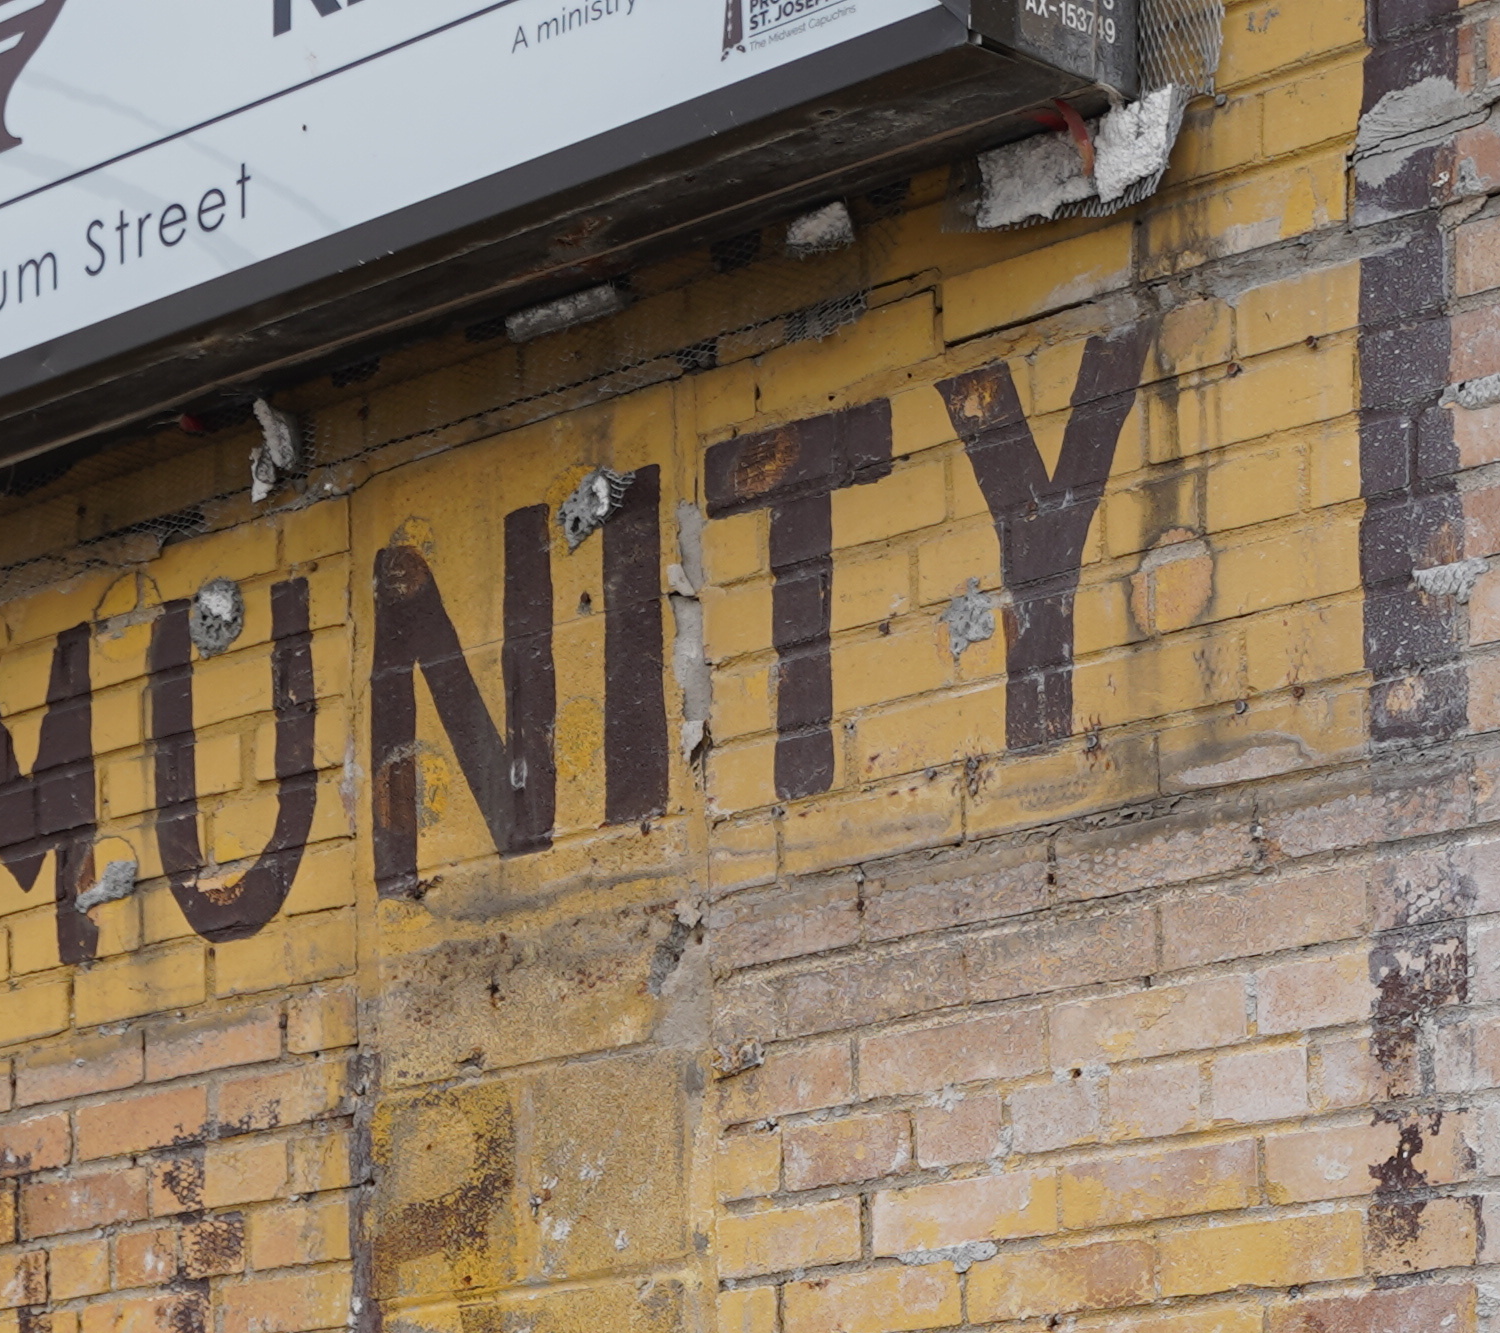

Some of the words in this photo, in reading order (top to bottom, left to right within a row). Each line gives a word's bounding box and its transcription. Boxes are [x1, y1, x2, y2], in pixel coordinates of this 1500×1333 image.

[512, 25, 528, 54] A
[749, 39, 767, 51] The
[768, 22, 807, 44] Midwest
[807, 5, 857, 30] Capuchins
[84, 162, 252, 277] Street
